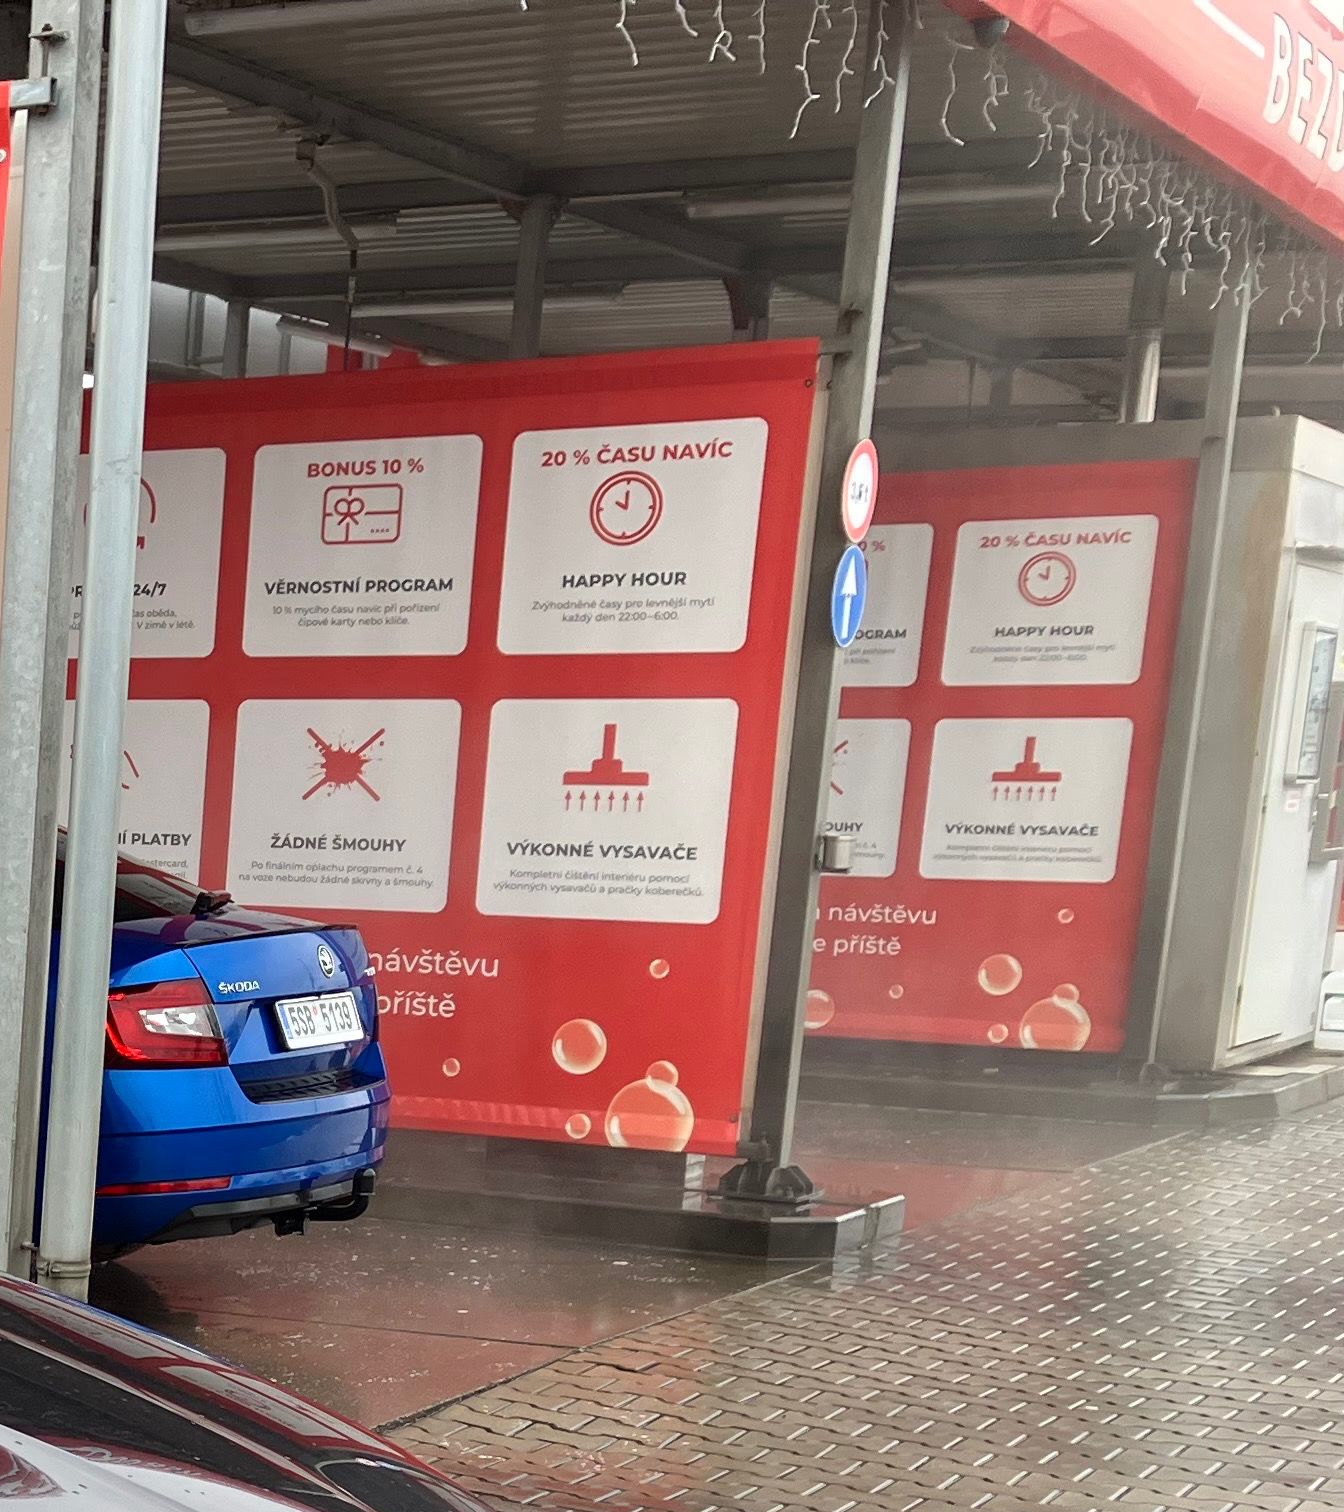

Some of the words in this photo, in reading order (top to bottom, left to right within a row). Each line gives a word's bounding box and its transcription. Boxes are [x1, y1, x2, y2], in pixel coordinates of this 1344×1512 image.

[541, 451, 566, 467] 20
[573, 449, 590, 465] %
[597, 443, 656, 464] ČASU
[663, 437, 734, 461] NAVÍC
[307, 461, 376, 478] BONUS
[382, 459, 402, 474] 10
[408, 457, 424, 473] %
[980, 535, 1001, 548] 20
[1005, 534, 1020, 547] %
[1025, 531, 1072, 546] ČASU
[1076, 529, 1132, 544] NAVÍC
[133, 581, 167, 597] 24/7
[264, 577, 362, 595] VĚRNOSTNÍ
[365, 578, 453, 593] PROGRAM
[562, 572, 627, 589] HAPPY
[631, 571, 687, 586] HOUR
[625, 600, 643, 610] pro
[595, 612, 615, 621] den
[854, 629, 907, 640] OGRAM
[994, 625, 1046, 637] HAPPY
[1050, 625, 1094, 636] HOUR
[945, 822, 1015, 835] VÝKONNÉ
[1020, 824, 1099, 836] VYSAVAČE
[131, 833, 192, 846] PLATBY
[270, 832, 327, 850] ŽÁDNÉ
[332, 833, 406, 852] ŠMOUHY
[507, 839, 594, 858] VÝKONNÉ
[599, 843, 698, 860] VYSAVAČE
[829, 902, 937, 925] návštěvu
[833, 934, 902, 956] příště
[218, 980, 260, 994] ŠKODA
[288, 1005, 316, 1037] 5SB
